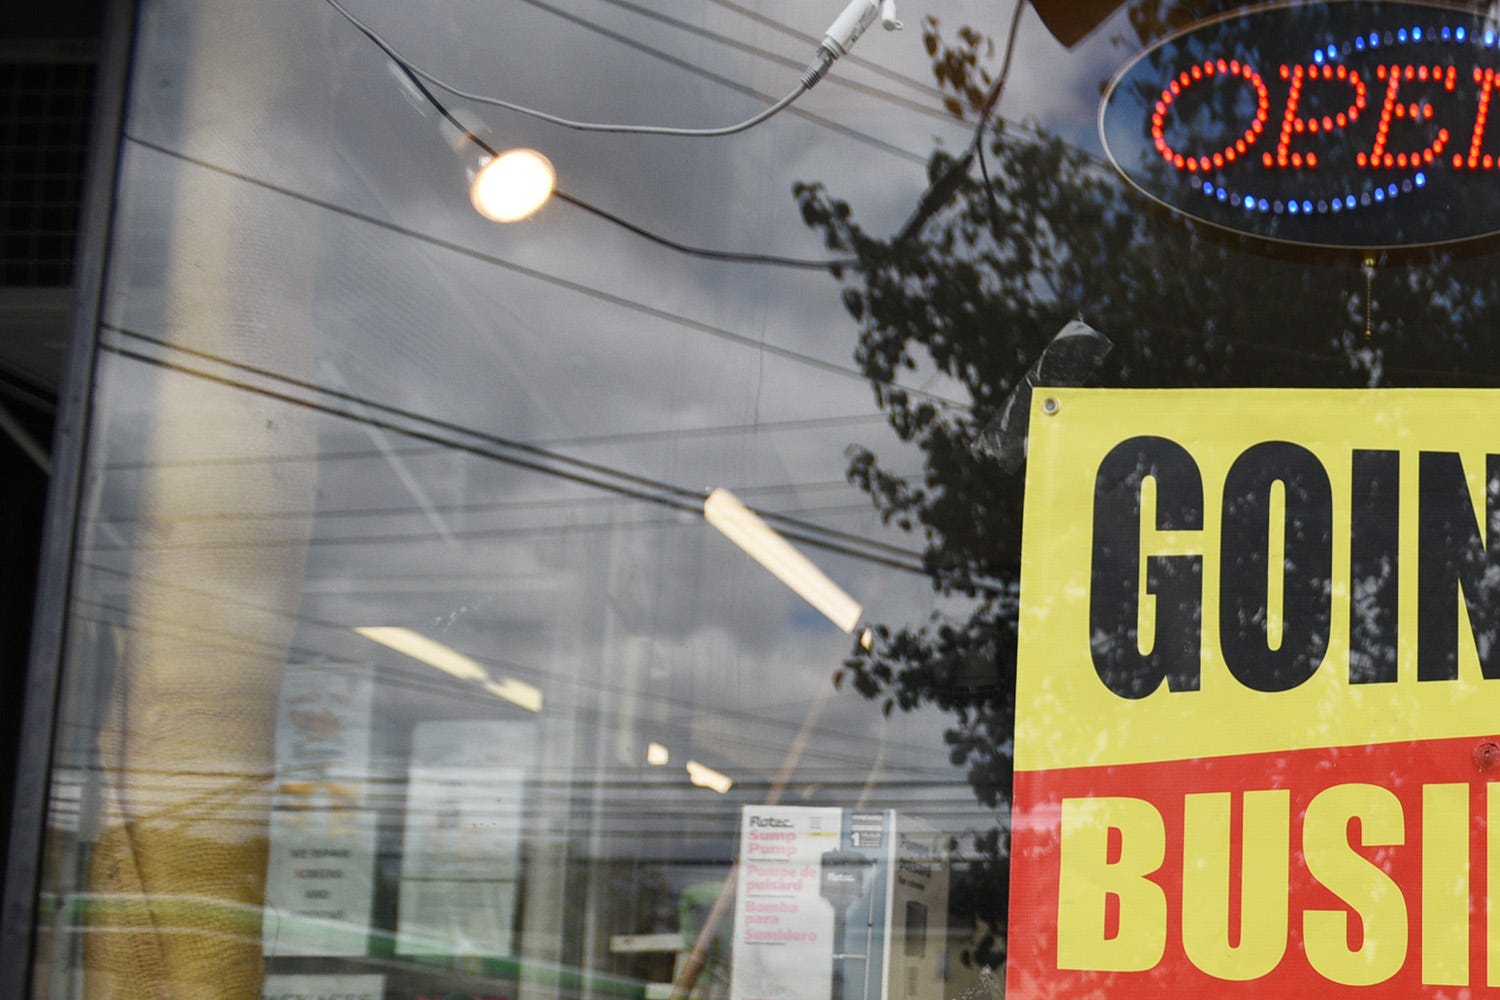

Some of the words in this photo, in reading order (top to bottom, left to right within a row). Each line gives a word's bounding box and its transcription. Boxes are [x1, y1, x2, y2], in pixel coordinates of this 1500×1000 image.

[749, 830, 797, 845] Sump
[749, 843, 797, 856] Pump
[745, 901, 798, 913] Bomba
[744, 927, 817, 941] Sumidero
